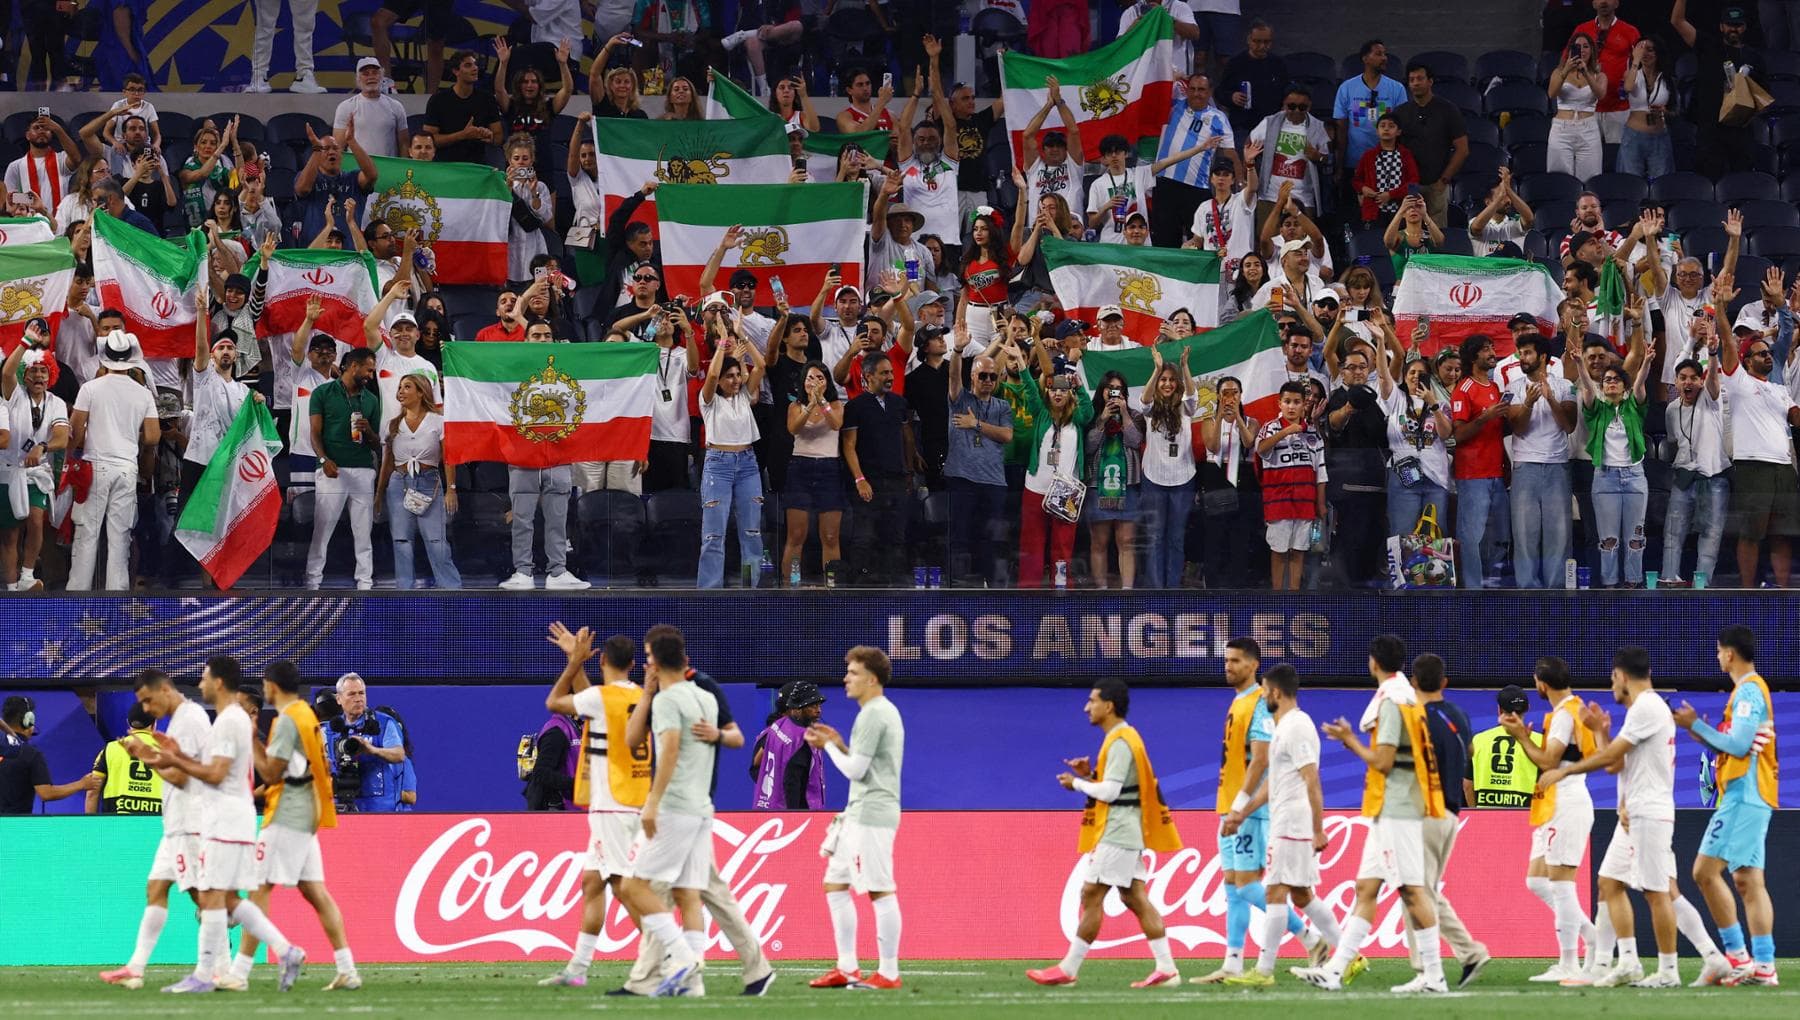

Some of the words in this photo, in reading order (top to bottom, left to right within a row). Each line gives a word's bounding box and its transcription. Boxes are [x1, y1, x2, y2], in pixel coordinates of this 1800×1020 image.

[1189, 119, 1203, 133] 10
[1278, 132, 1306, 147] IRAN
[887, 614, 1014, 660] LOS
[1032, 613, 1331, 660] ANGELES
[128, 785, 152, 793] 2026
[115, 798, 161, 813] ECURIT
[1477, 792, 1528, 807] ECURITY
[1234, 833, 1254, 854] 22
[1548, 827, 1556, 845] 7
